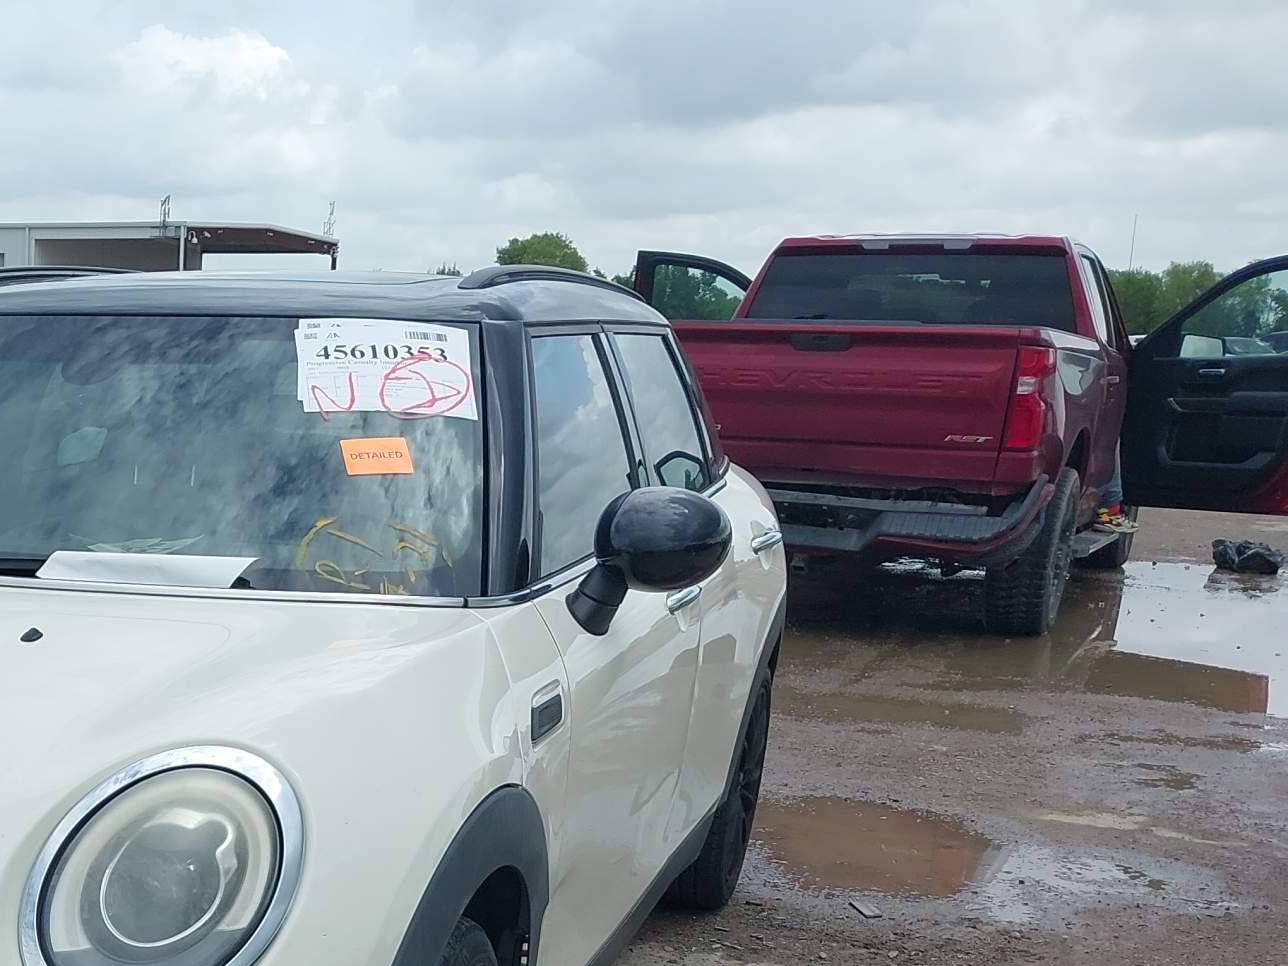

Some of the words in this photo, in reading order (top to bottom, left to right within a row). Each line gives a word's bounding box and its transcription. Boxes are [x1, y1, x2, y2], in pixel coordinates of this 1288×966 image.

[315, 343, 448, 362] 45610353
[697, 366, 988, 393] HEVROLET
[350, 451, 404, 461] DETAILED
